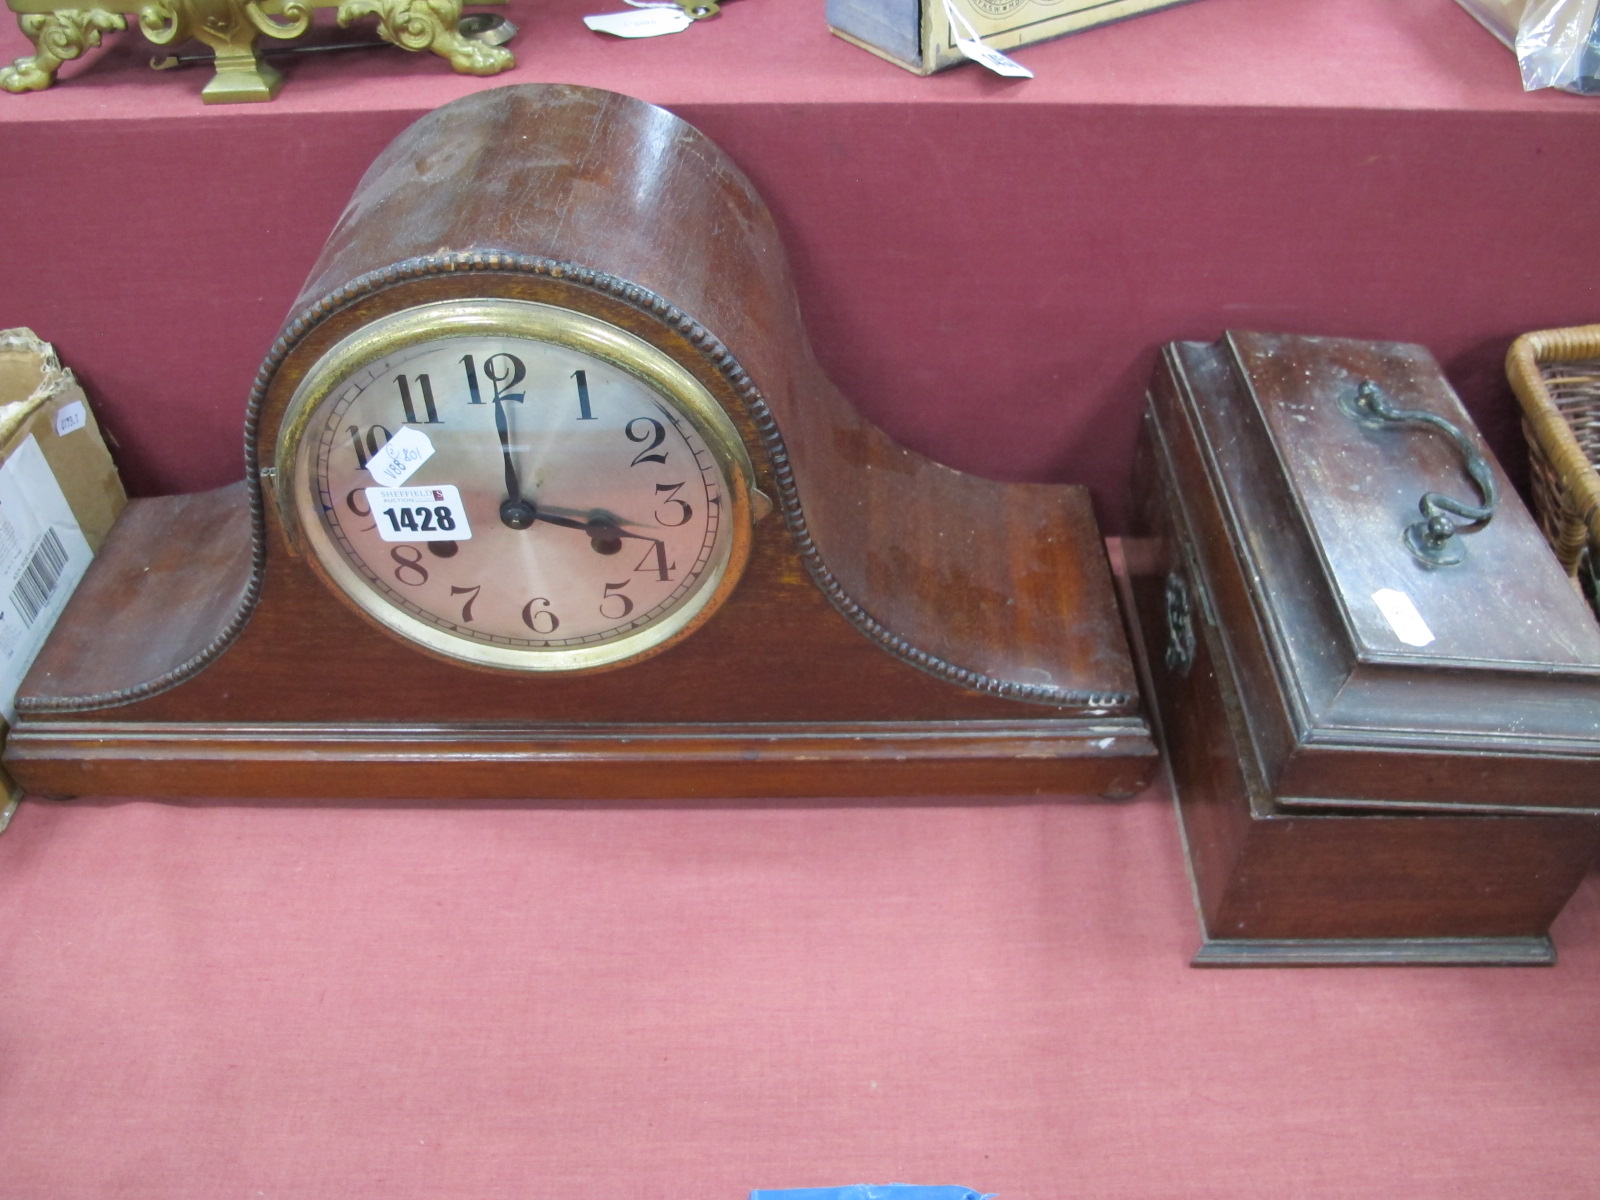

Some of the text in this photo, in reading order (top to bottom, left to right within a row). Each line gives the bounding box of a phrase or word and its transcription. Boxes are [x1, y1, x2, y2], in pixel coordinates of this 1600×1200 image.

[393, 374, 445, 424] 11
[458, 353, 527, 405] 12
[570, 370, 598, 420] 1
[345, 424, 393, 470] 10
[624, 417, 669, 467] 2
[380, 490, 433, 498] SHEFFIELD
[654, 482, 693, 527] 3
[383, 506, 456, 532] 1428
[390, 544, 429, 587] 8
[633, 540, 677, 582] 4
[450, 585, 481, 623] 7
[521, 597, 560, 634] 6
[599, 578, 634, 620] 5
